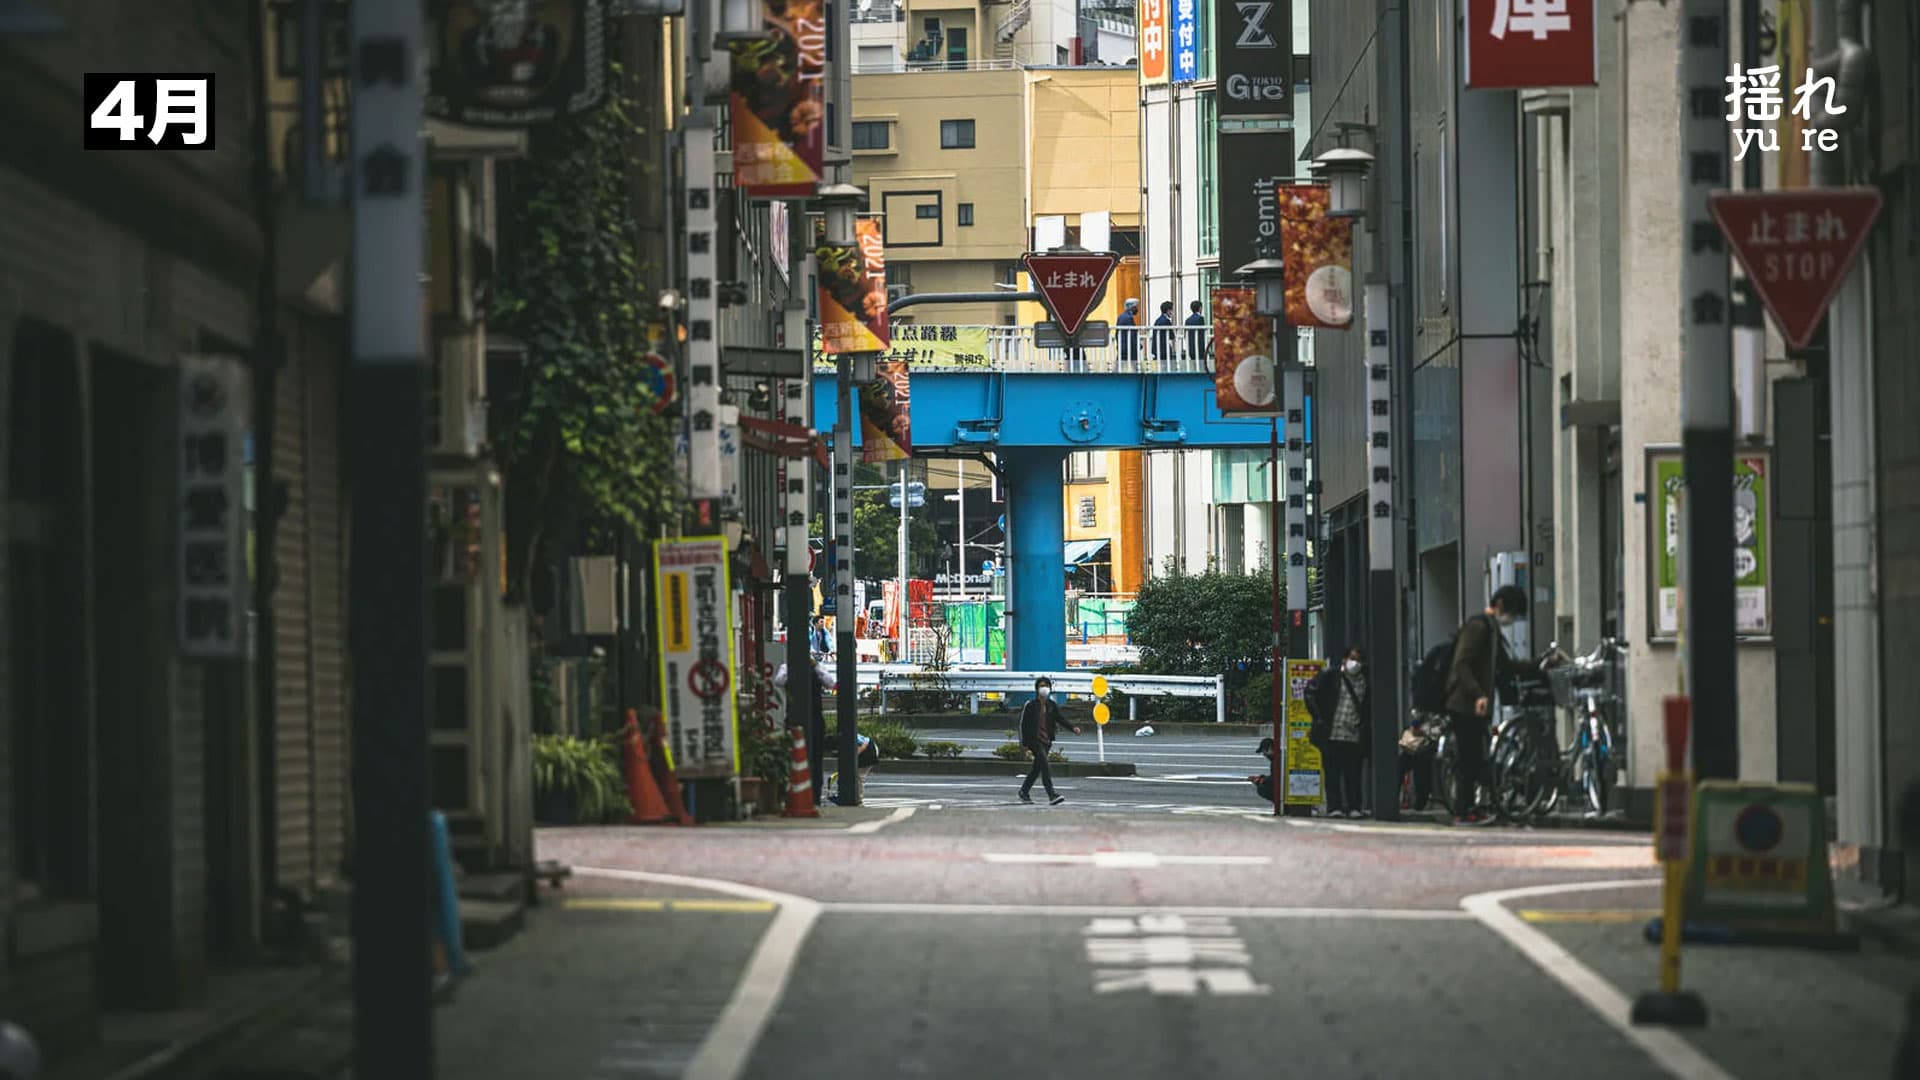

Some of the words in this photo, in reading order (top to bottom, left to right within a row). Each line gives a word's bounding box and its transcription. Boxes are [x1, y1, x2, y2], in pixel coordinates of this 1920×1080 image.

[796, 17, 826, 83] 2021
[1747, 209, 1848, 246] 止まれ
[861, 233, 886, 280] 2021
[1764, 252, 1836, 284] STOP
[1045, 270, 1097, 289] 止まれ
[892, 371, 911, 407] 2021
